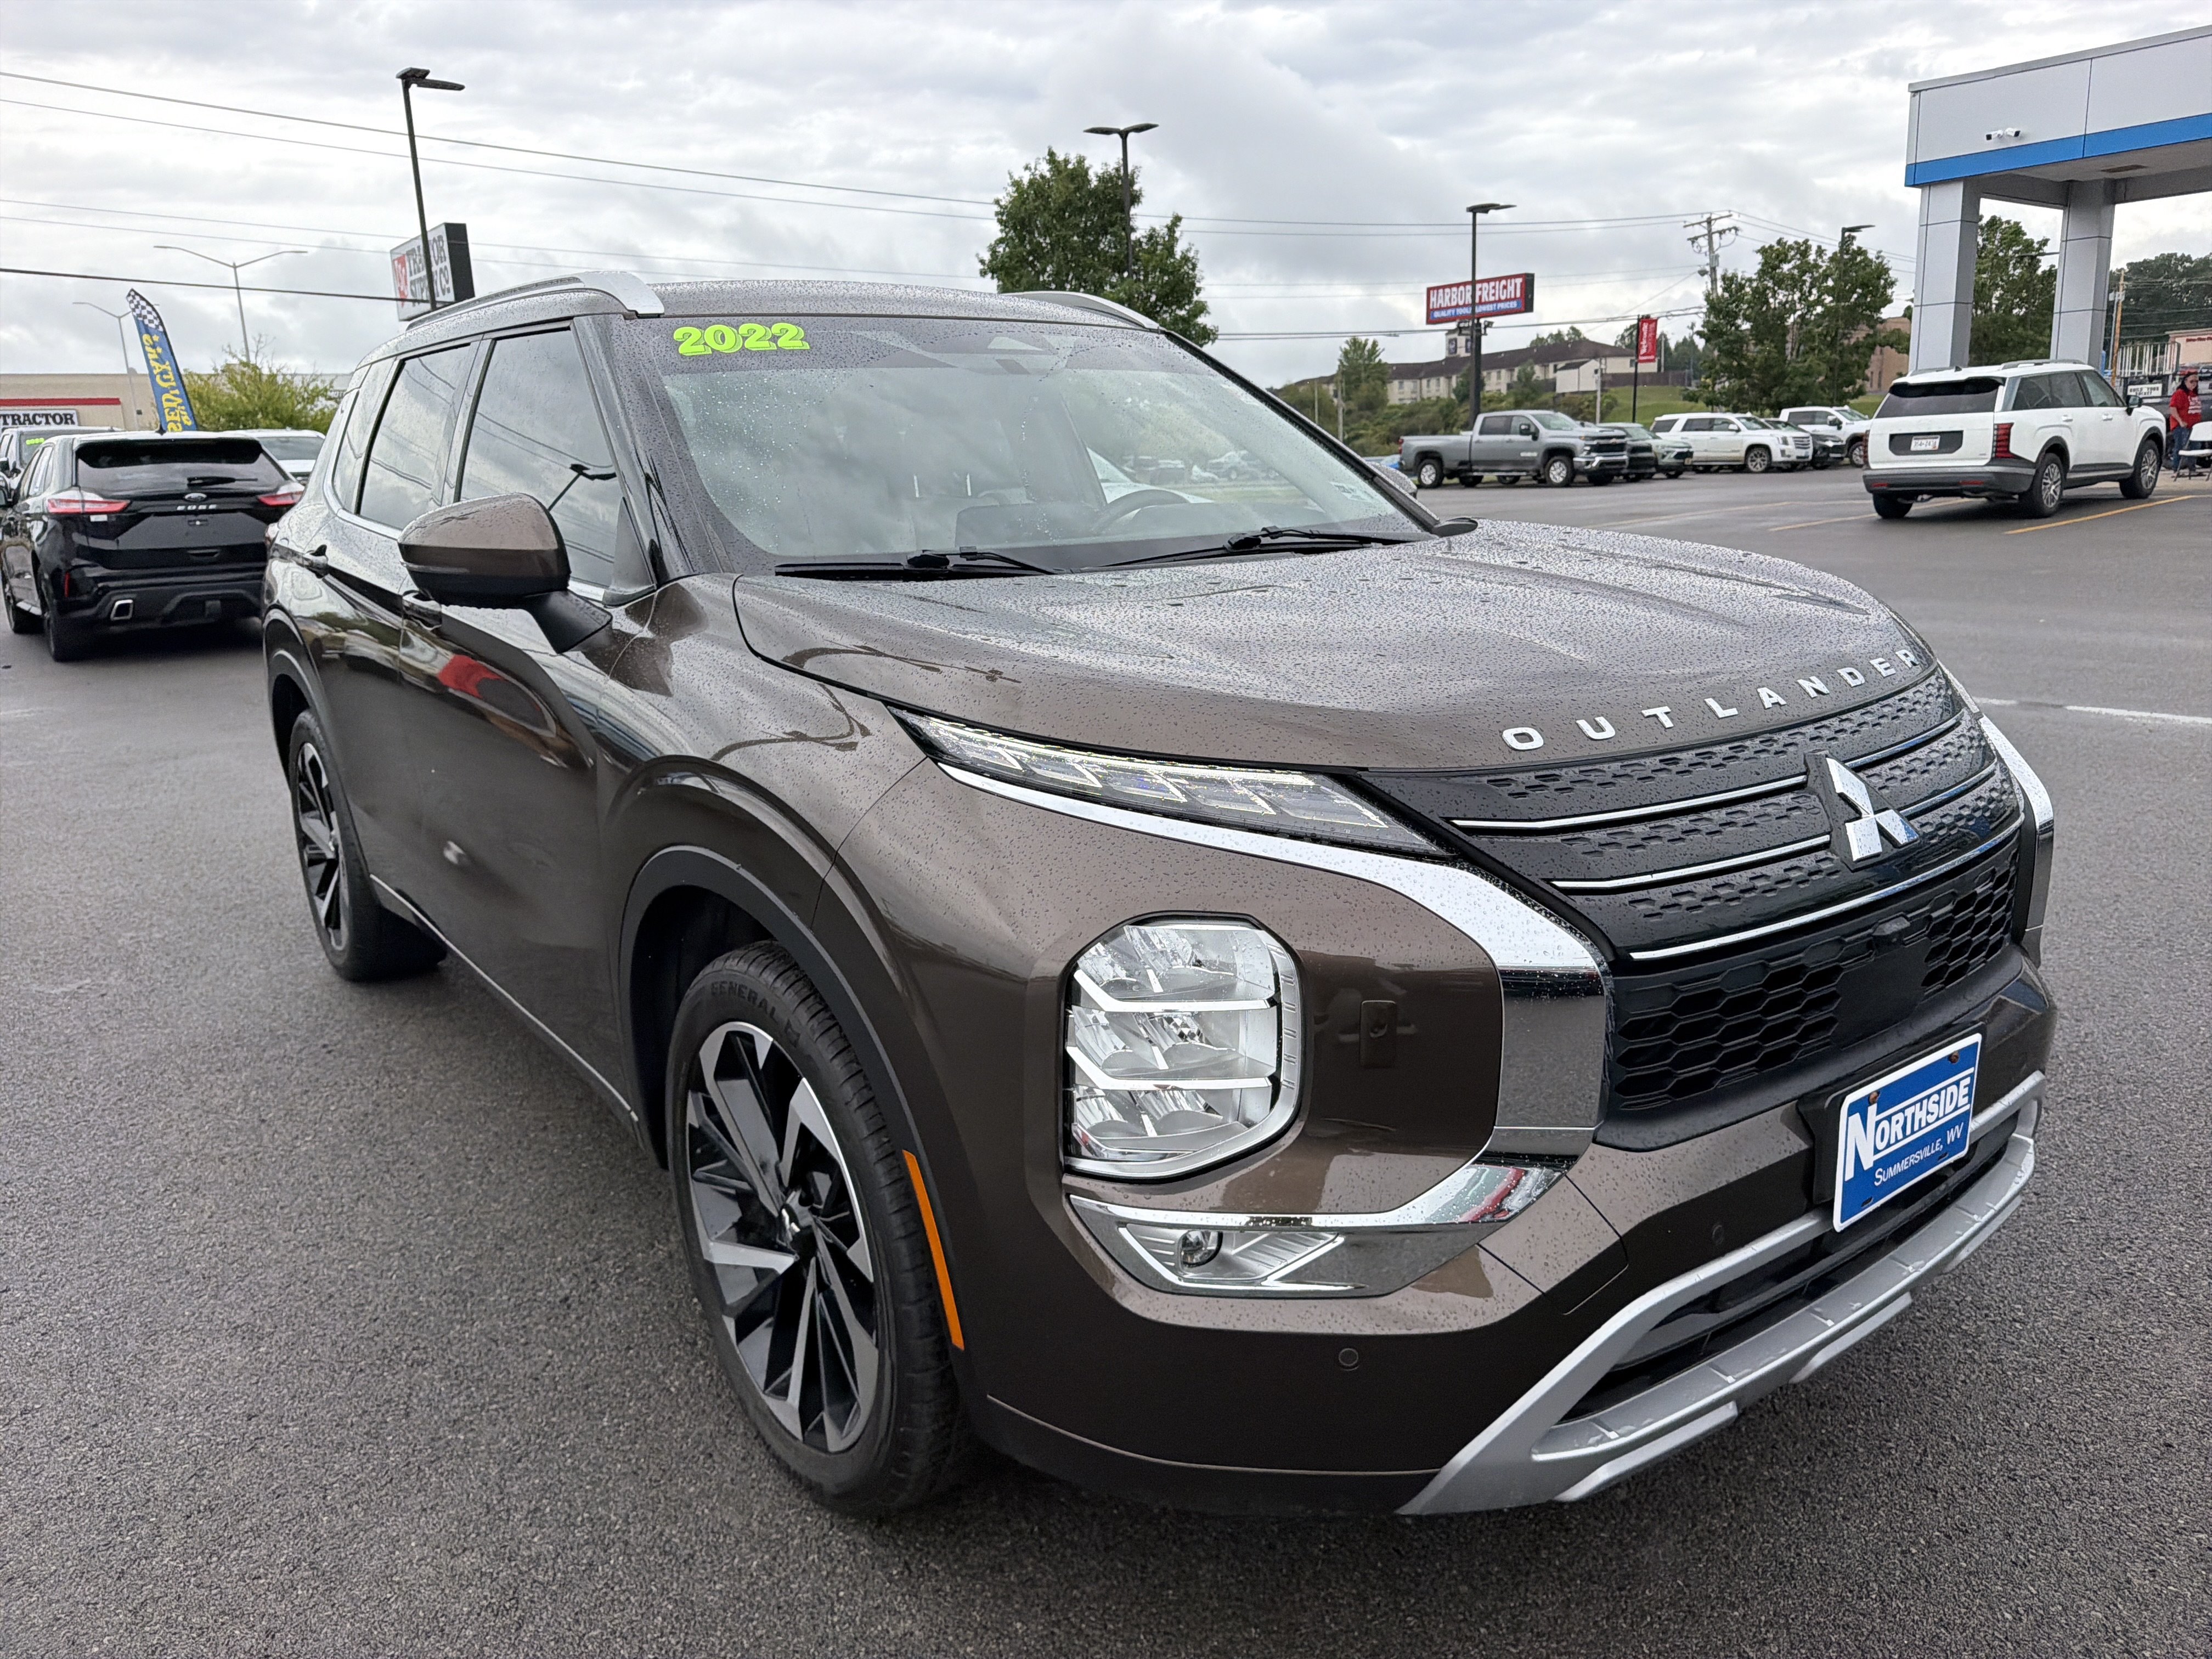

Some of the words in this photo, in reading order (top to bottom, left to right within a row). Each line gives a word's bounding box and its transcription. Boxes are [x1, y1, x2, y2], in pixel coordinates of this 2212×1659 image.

[406, 235, 447, 277] TRAOR
[1430, 285, 1472, 309] HARBOR
[1475, 278, 1522, 303] FREIGHT
[1497, 300, 1517, 310] PRICES
[673, 323, 810, 357] 2022
[0, 413, 76, 426] TRACTOR
[1502, 648, 1920, 751] OUTLANDER
[710, 980, 778, 1024] GENERAL
[1844, 1076, 1971, 1182] NORTHSIDE
[1874, 1138, 1944, 1187] SUMMERSVILLE,
[1946, 1122, 1964, 1146] WV
